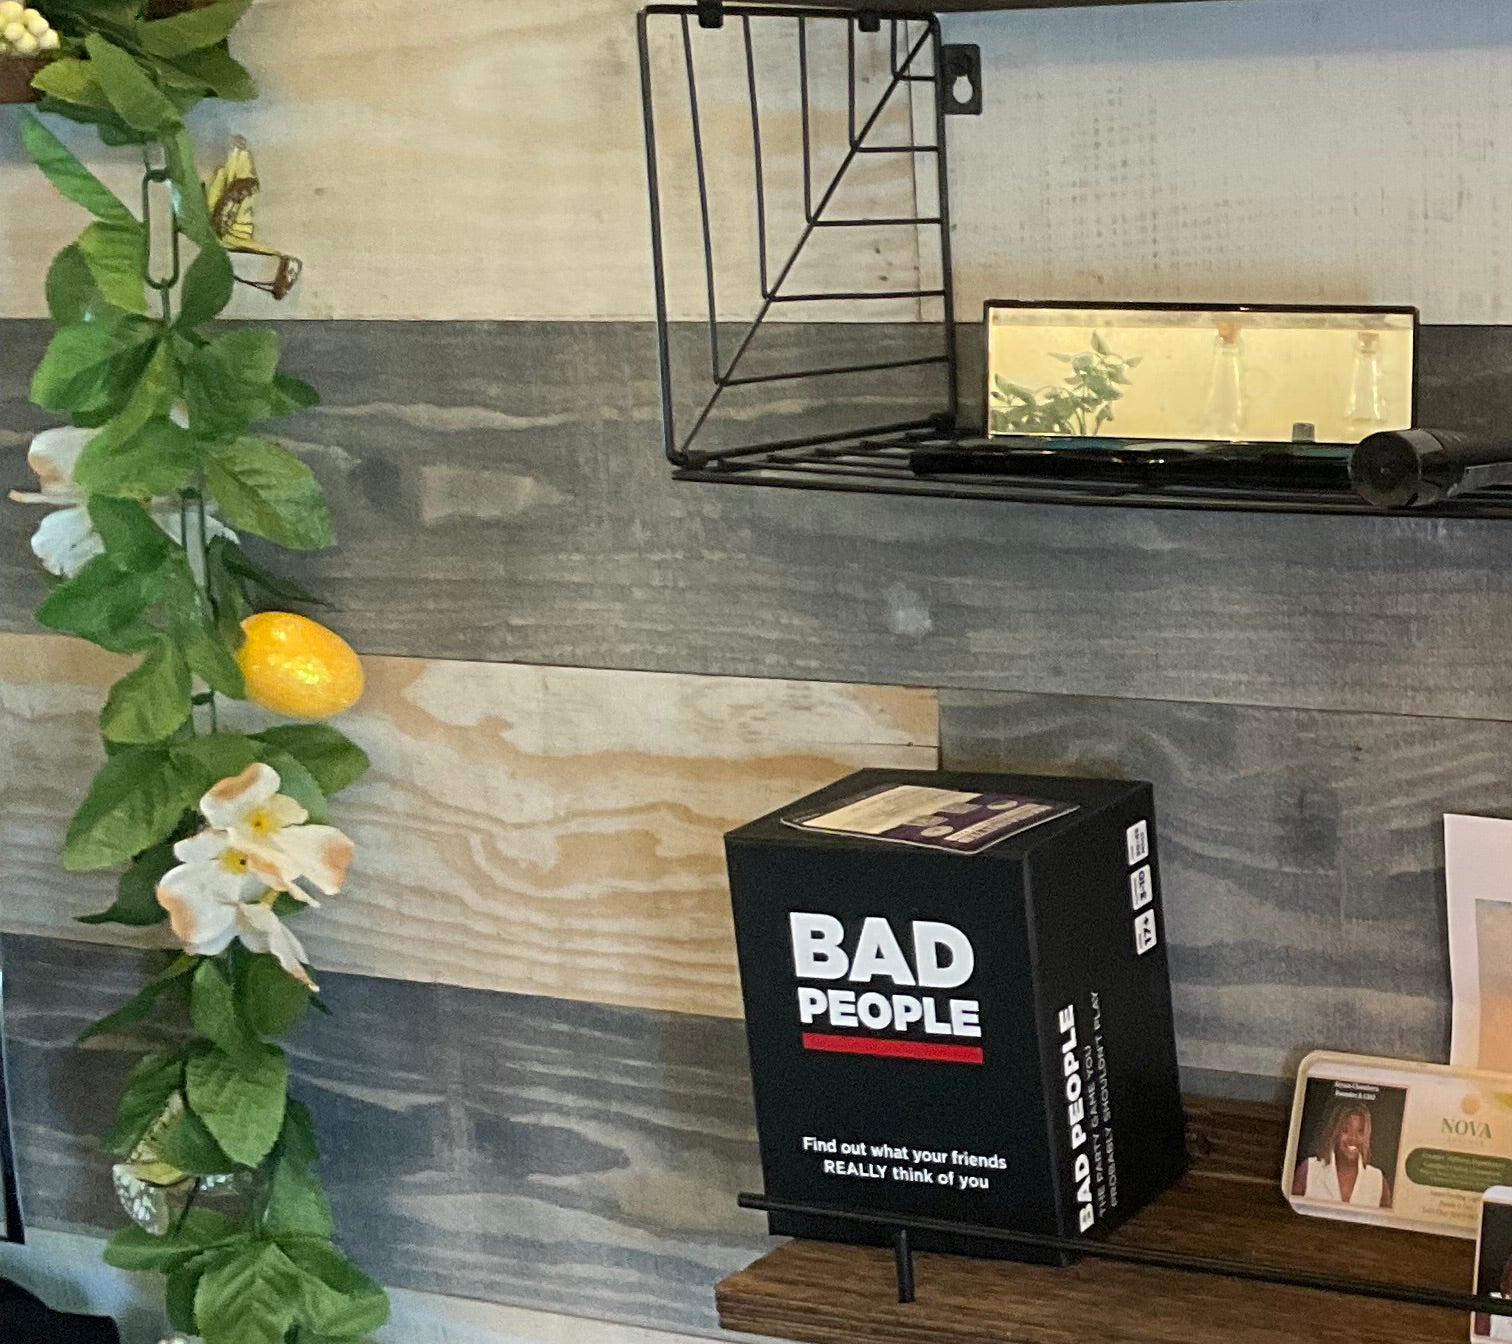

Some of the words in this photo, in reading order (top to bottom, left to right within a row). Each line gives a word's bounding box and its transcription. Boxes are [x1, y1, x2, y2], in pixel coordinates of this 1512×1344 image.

[789, 911, 975, 989] BAD
[797, 987, 983, 1038] PEOPLE
[1058, 1004, 1087, 1150] PEOPLE
[1084, 1045, 1094, 1082] YOU
[1087, 1081, 1099, 1128] GAME
[1441, 1117, 1493, 1140] NOVA
[802, 1137, 837, 1153] Find
[841, 1142, 867, 1156] out
[870, 1144, 909, 1160] what
[912, 1149, 948, 1164] your
[951, 1150, 1008, 1170] friends
[823, 1159, 888, 1179] REALLY
[892, 1166, 934, 1184] think
[937, 1171, 955, 1185] of
[958, 1175, 990, 1190] you
[1093, 1134, 1104, 1183] PARTY
[1075, 1153, 1095, 1233] BAD
